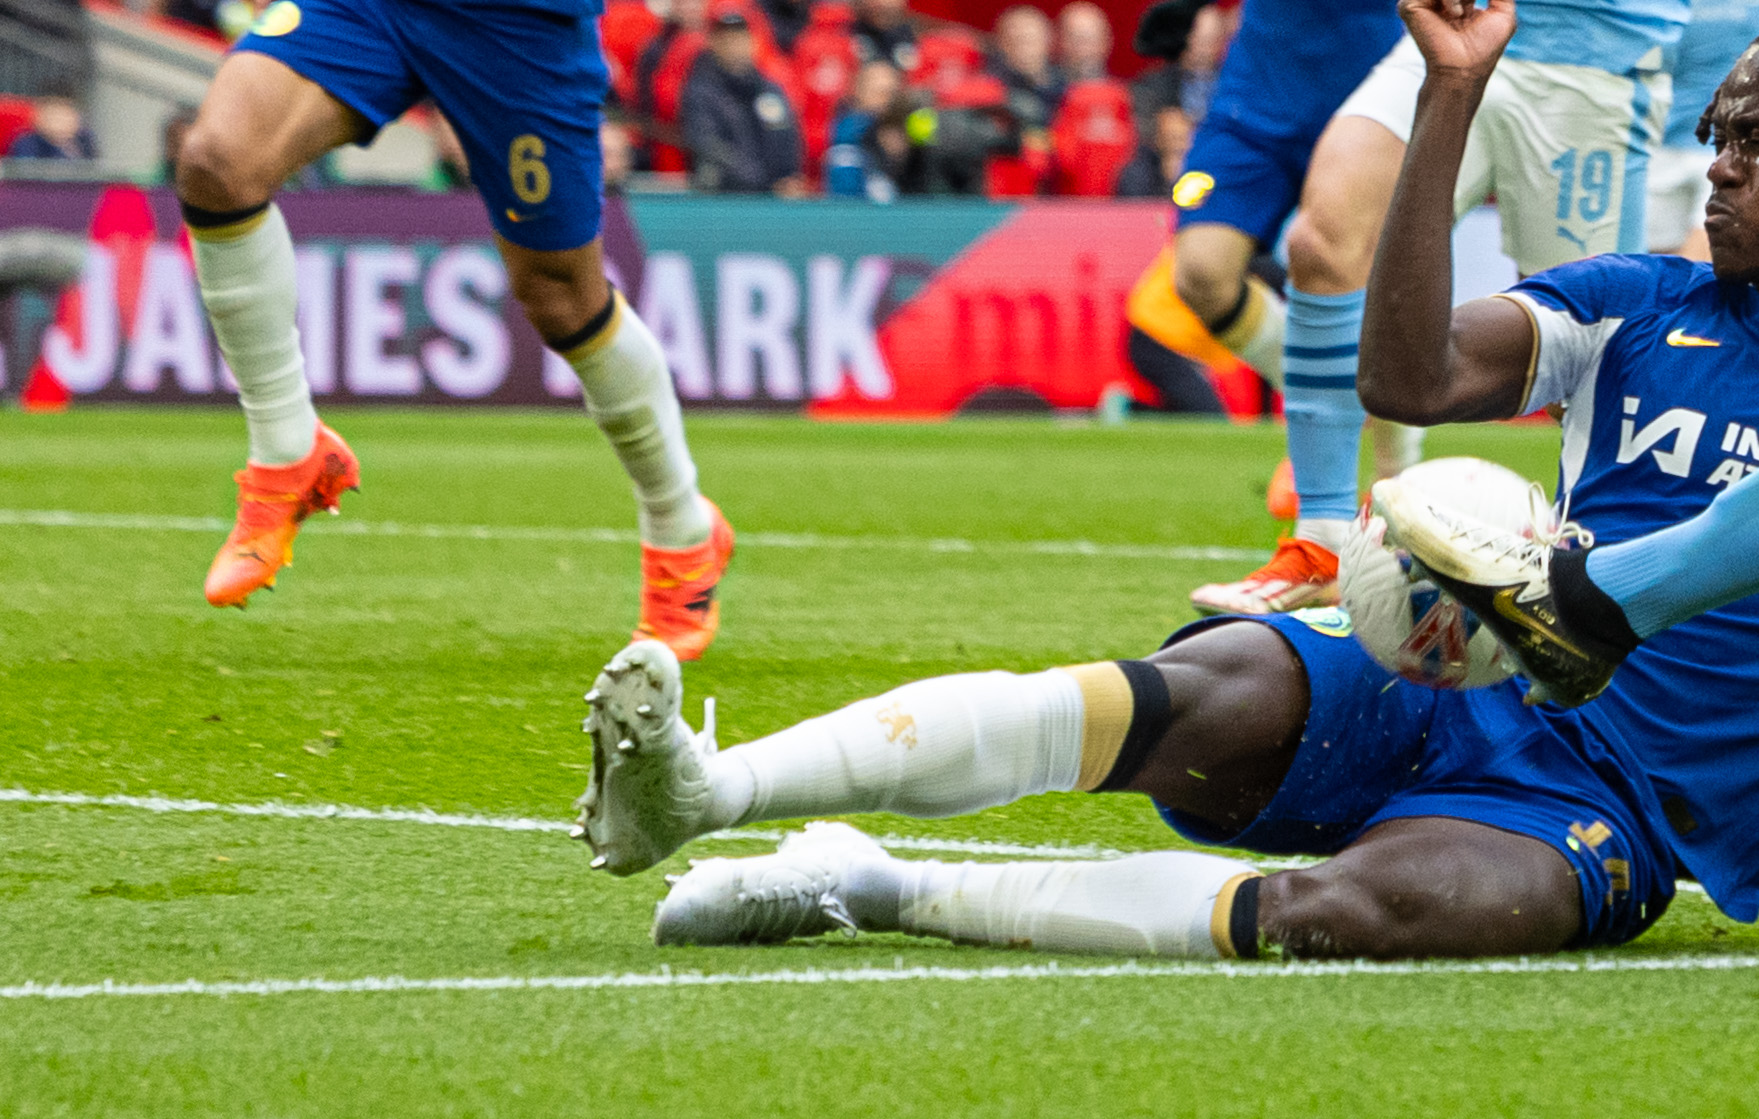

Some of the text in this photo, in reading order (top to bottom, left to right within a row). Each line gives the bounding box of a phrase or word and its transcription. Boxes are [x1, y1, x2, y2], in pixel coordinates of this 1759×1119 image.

[508, 133, 552, 205] 6
[1551, 147, 1614, 222] 19
[542, 250, 896, 400] ARK
